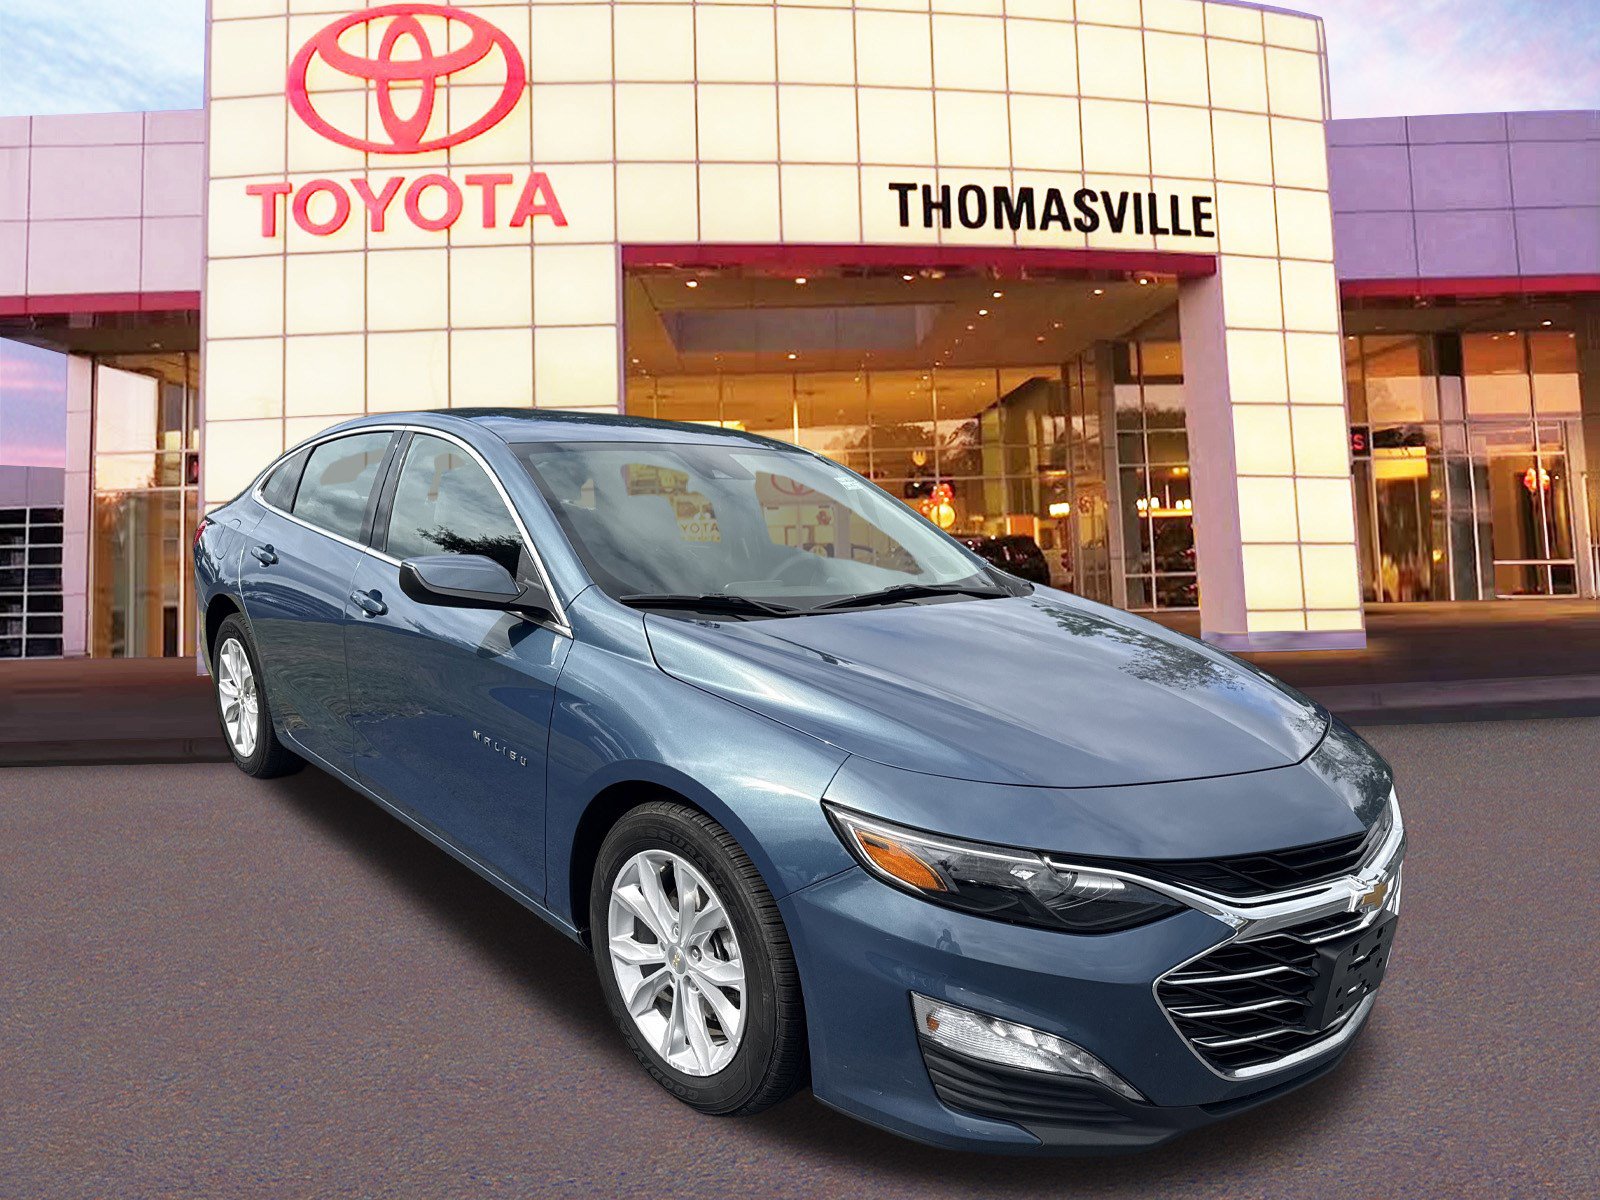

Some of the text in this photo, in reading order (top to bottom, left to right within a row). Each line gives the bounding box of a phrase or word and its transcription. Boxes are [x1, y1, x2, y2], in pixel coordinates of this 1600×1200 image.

[246, 172, 568, 237] TOYOTA
[889, 183, 1215, 237] THOMASVILLE
[473, 730, 527, 766] MALIBU
